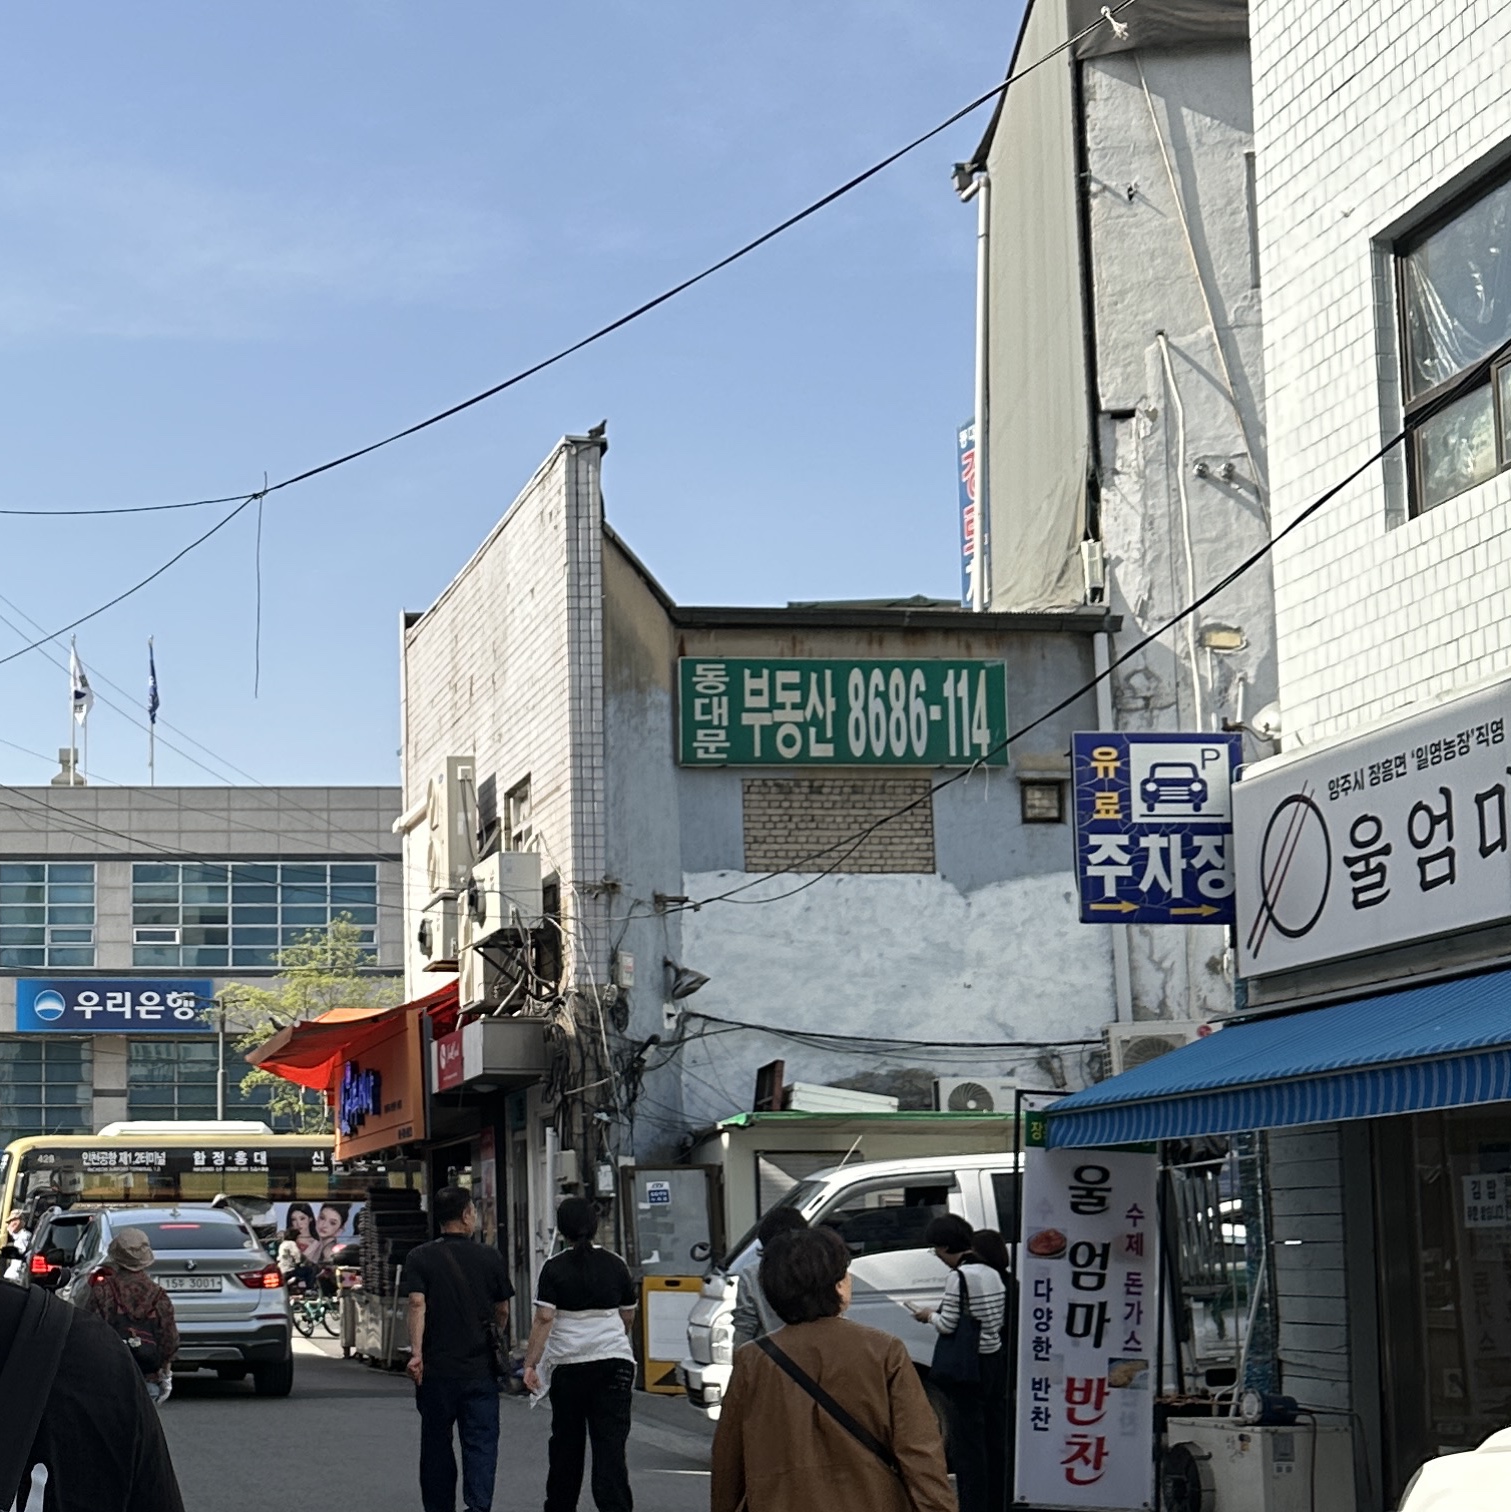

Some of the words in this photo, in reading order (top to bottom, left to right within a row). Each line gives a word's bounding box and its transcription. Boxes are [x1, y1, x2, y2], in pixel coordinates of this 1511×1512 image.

[692, 663, 731, 760] 동대문
[741, 669, 836, 756] 부동산
[846, 667, 991, 758] 8686-114
[1090, 746, 1121, 820] 유료
[1200, 748, 1221, 770] P
[1328, 776, 1366, 801] 양주시
[1086, 832, 1235, 899] 주차장
[72, 990, 196, 1021] 우리은행
[82, 1151, 117, 1166] 인천공항
[1065, 1164, 1113, 1349] 울엄마
[1125, 1202, 1145, 1258] 수제
[189, 1277, 216, 1289] 3001
[1122, 1270, 1144, 1352] 돈가스
[1031, 1277, 1054, 1362] 다양한
[1030, 1376, 1051, 1432] 반찬
[1060, 1376, 1111, 1487] 반찬
